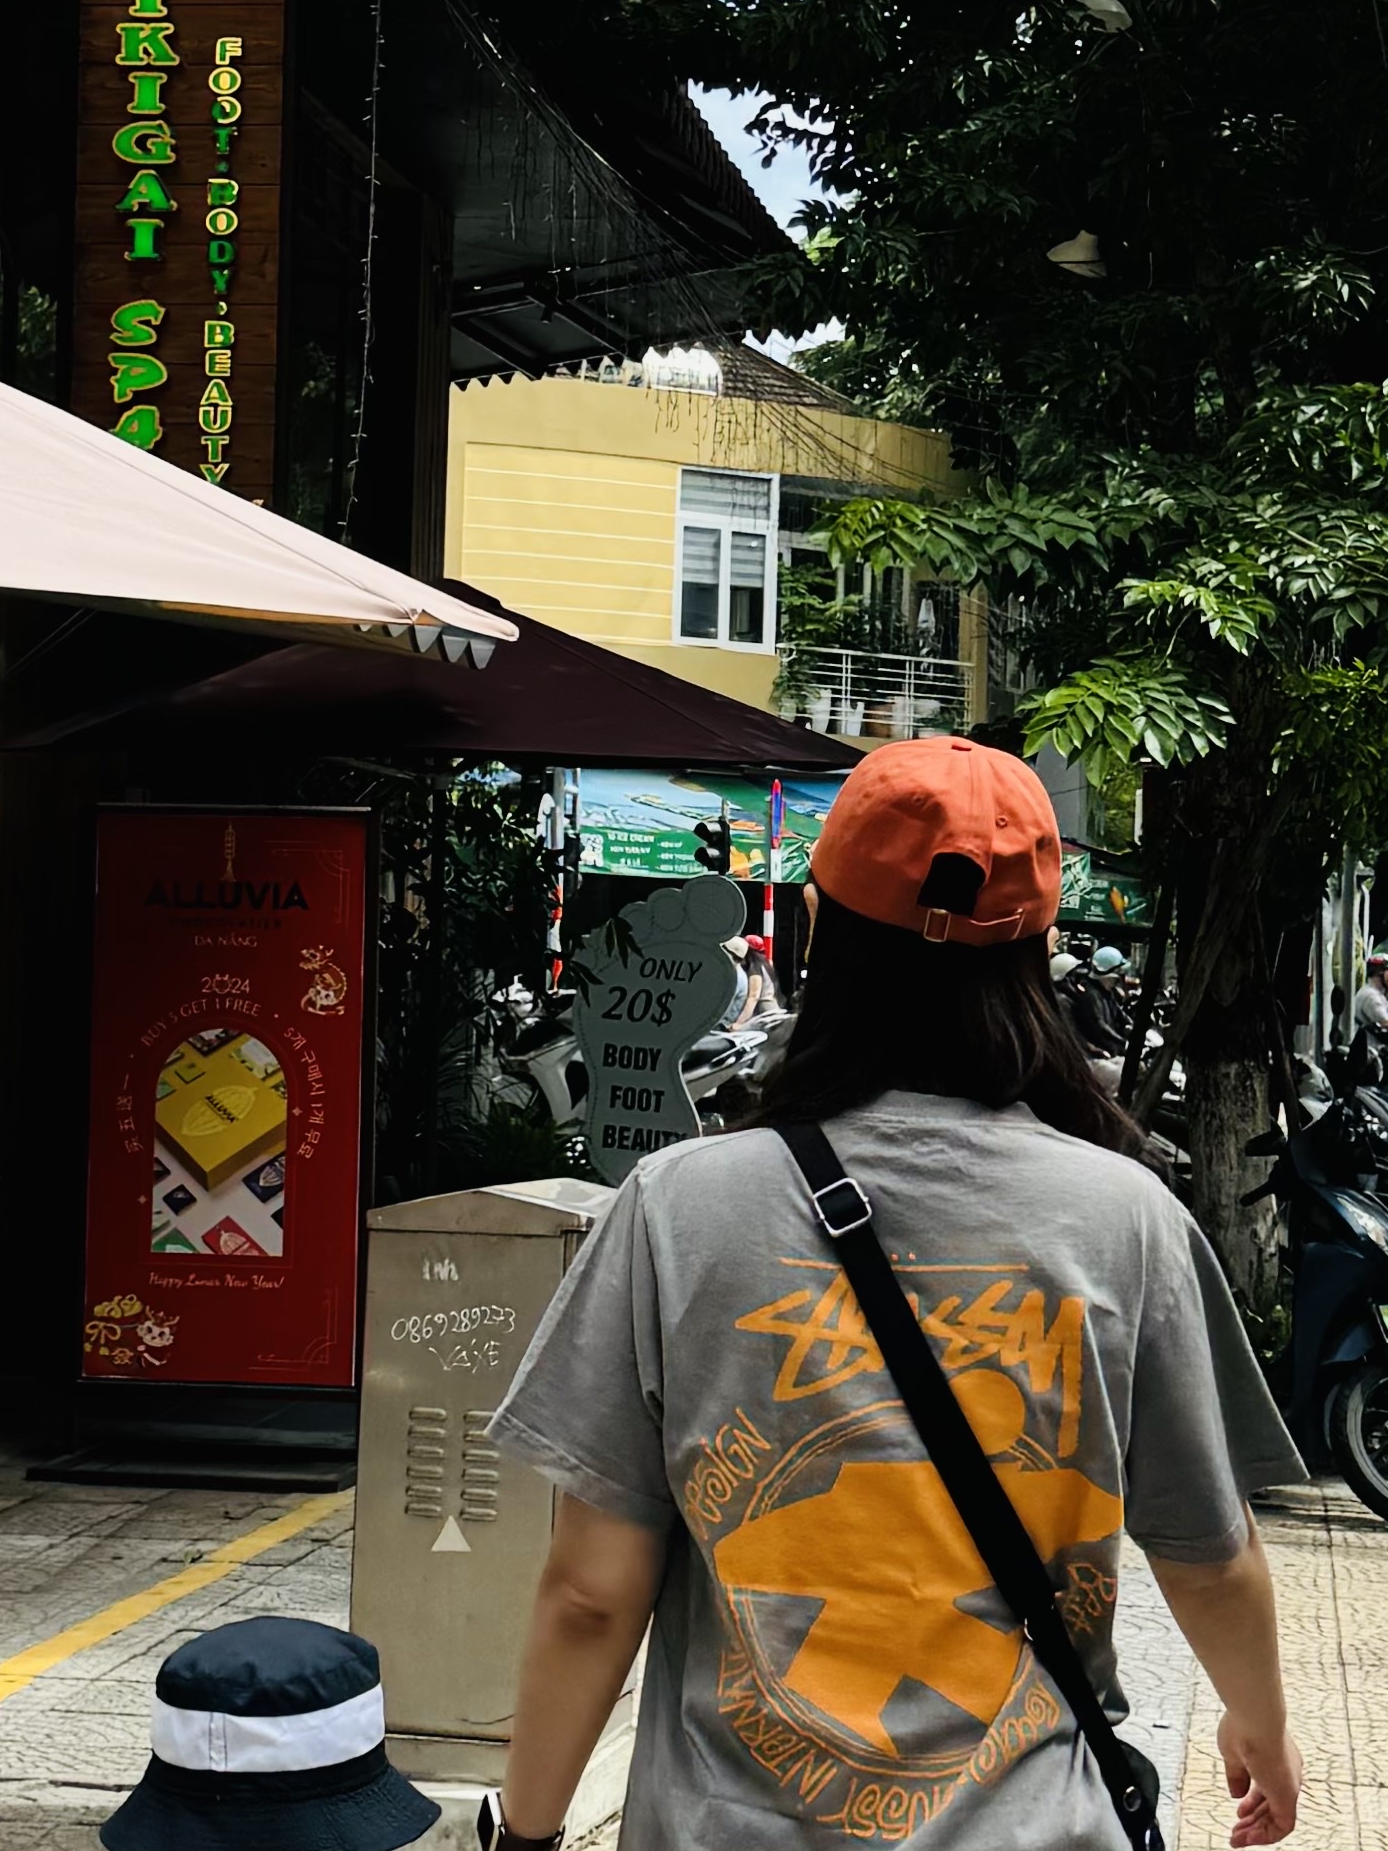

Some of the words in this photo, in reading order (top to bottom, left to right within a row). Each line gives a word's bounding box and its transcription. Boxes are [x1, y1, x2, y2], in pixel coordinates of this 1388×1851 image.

[208, 36, 242, 156] FOOT
[206, 177, 238, 296] BODY
[108, 299, 168, 450] SPA
[198, 320, 235, 484] BEAUTY
[143, 880, 310, 910] ALLUVIA
[640, 957, 703, 983] ONLY
[140, 1020, 167, 1047] BUY
[179, 998, 208, 1017] GET
[224, 997, 263, 1017] FREE
[601, 986, 676, 1027] 20$
[602, 1043, 662, 1072] BODY
[609, 1085, 665, 1113] FOOT
[602, 1125, 687, 1153] BEAUT
[149, 1271, 183, 1289] Happy
[185, 1273, 221, 1287] Lunar
[224, 1273, 249, 1287] New
[390, 1304, 517, 1344] 0869289273
